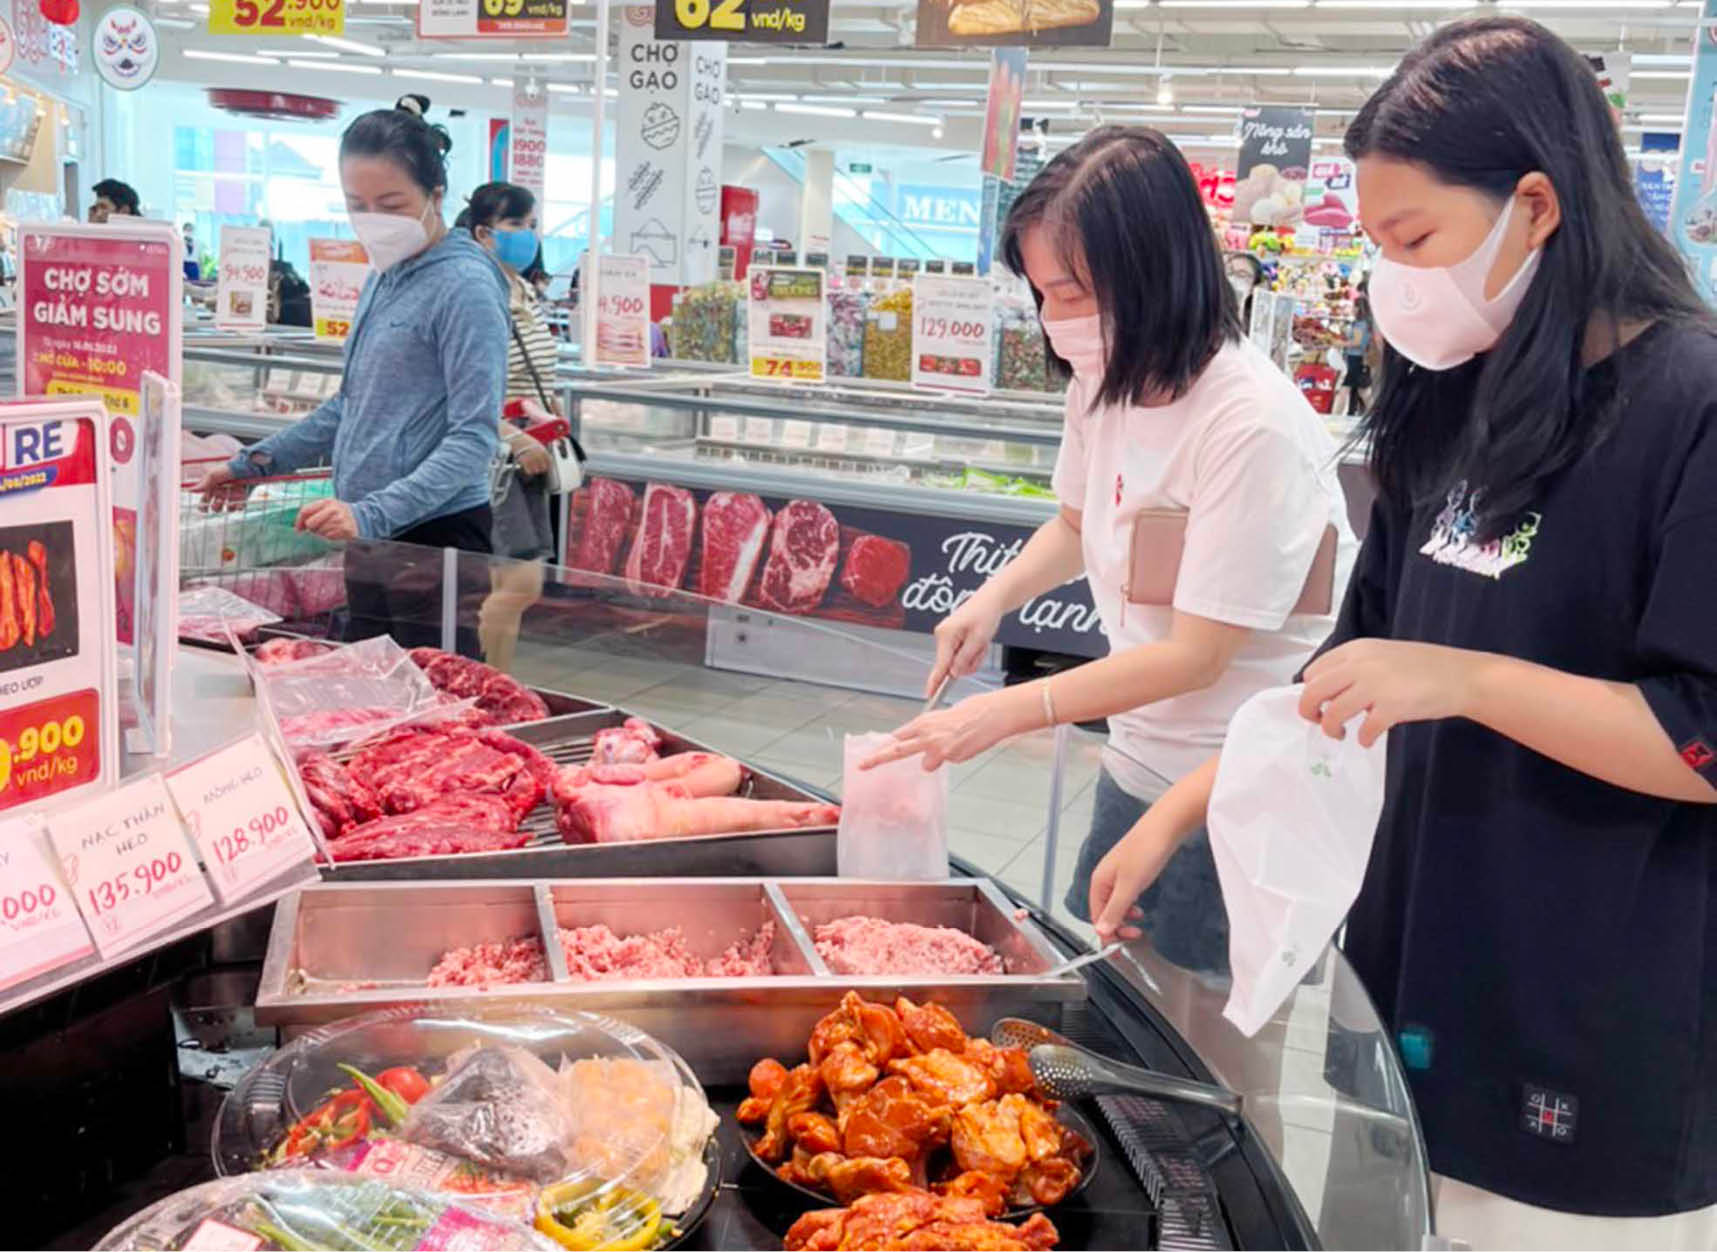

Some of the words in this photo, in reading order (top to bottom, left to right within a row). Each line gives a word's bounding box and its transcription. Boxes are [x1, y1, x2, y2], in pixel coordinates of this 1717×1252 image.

[751, 7, 806, 32] vnd/kg
[629, 70, 678, 94] GẠO
[44, 267, 92, 296] CHỢ
[95, 266, 149, 297] SỚM
[33, 294, 88, 328] GIẢM
[93, 306, 161, 335] SUNG
[16, 755, 79, 789] vnd/kg
[115, 832, 149, 857] HEO
[212, 805, 290, 866] 128.900
[88, 851, 183, 916] 135.900
